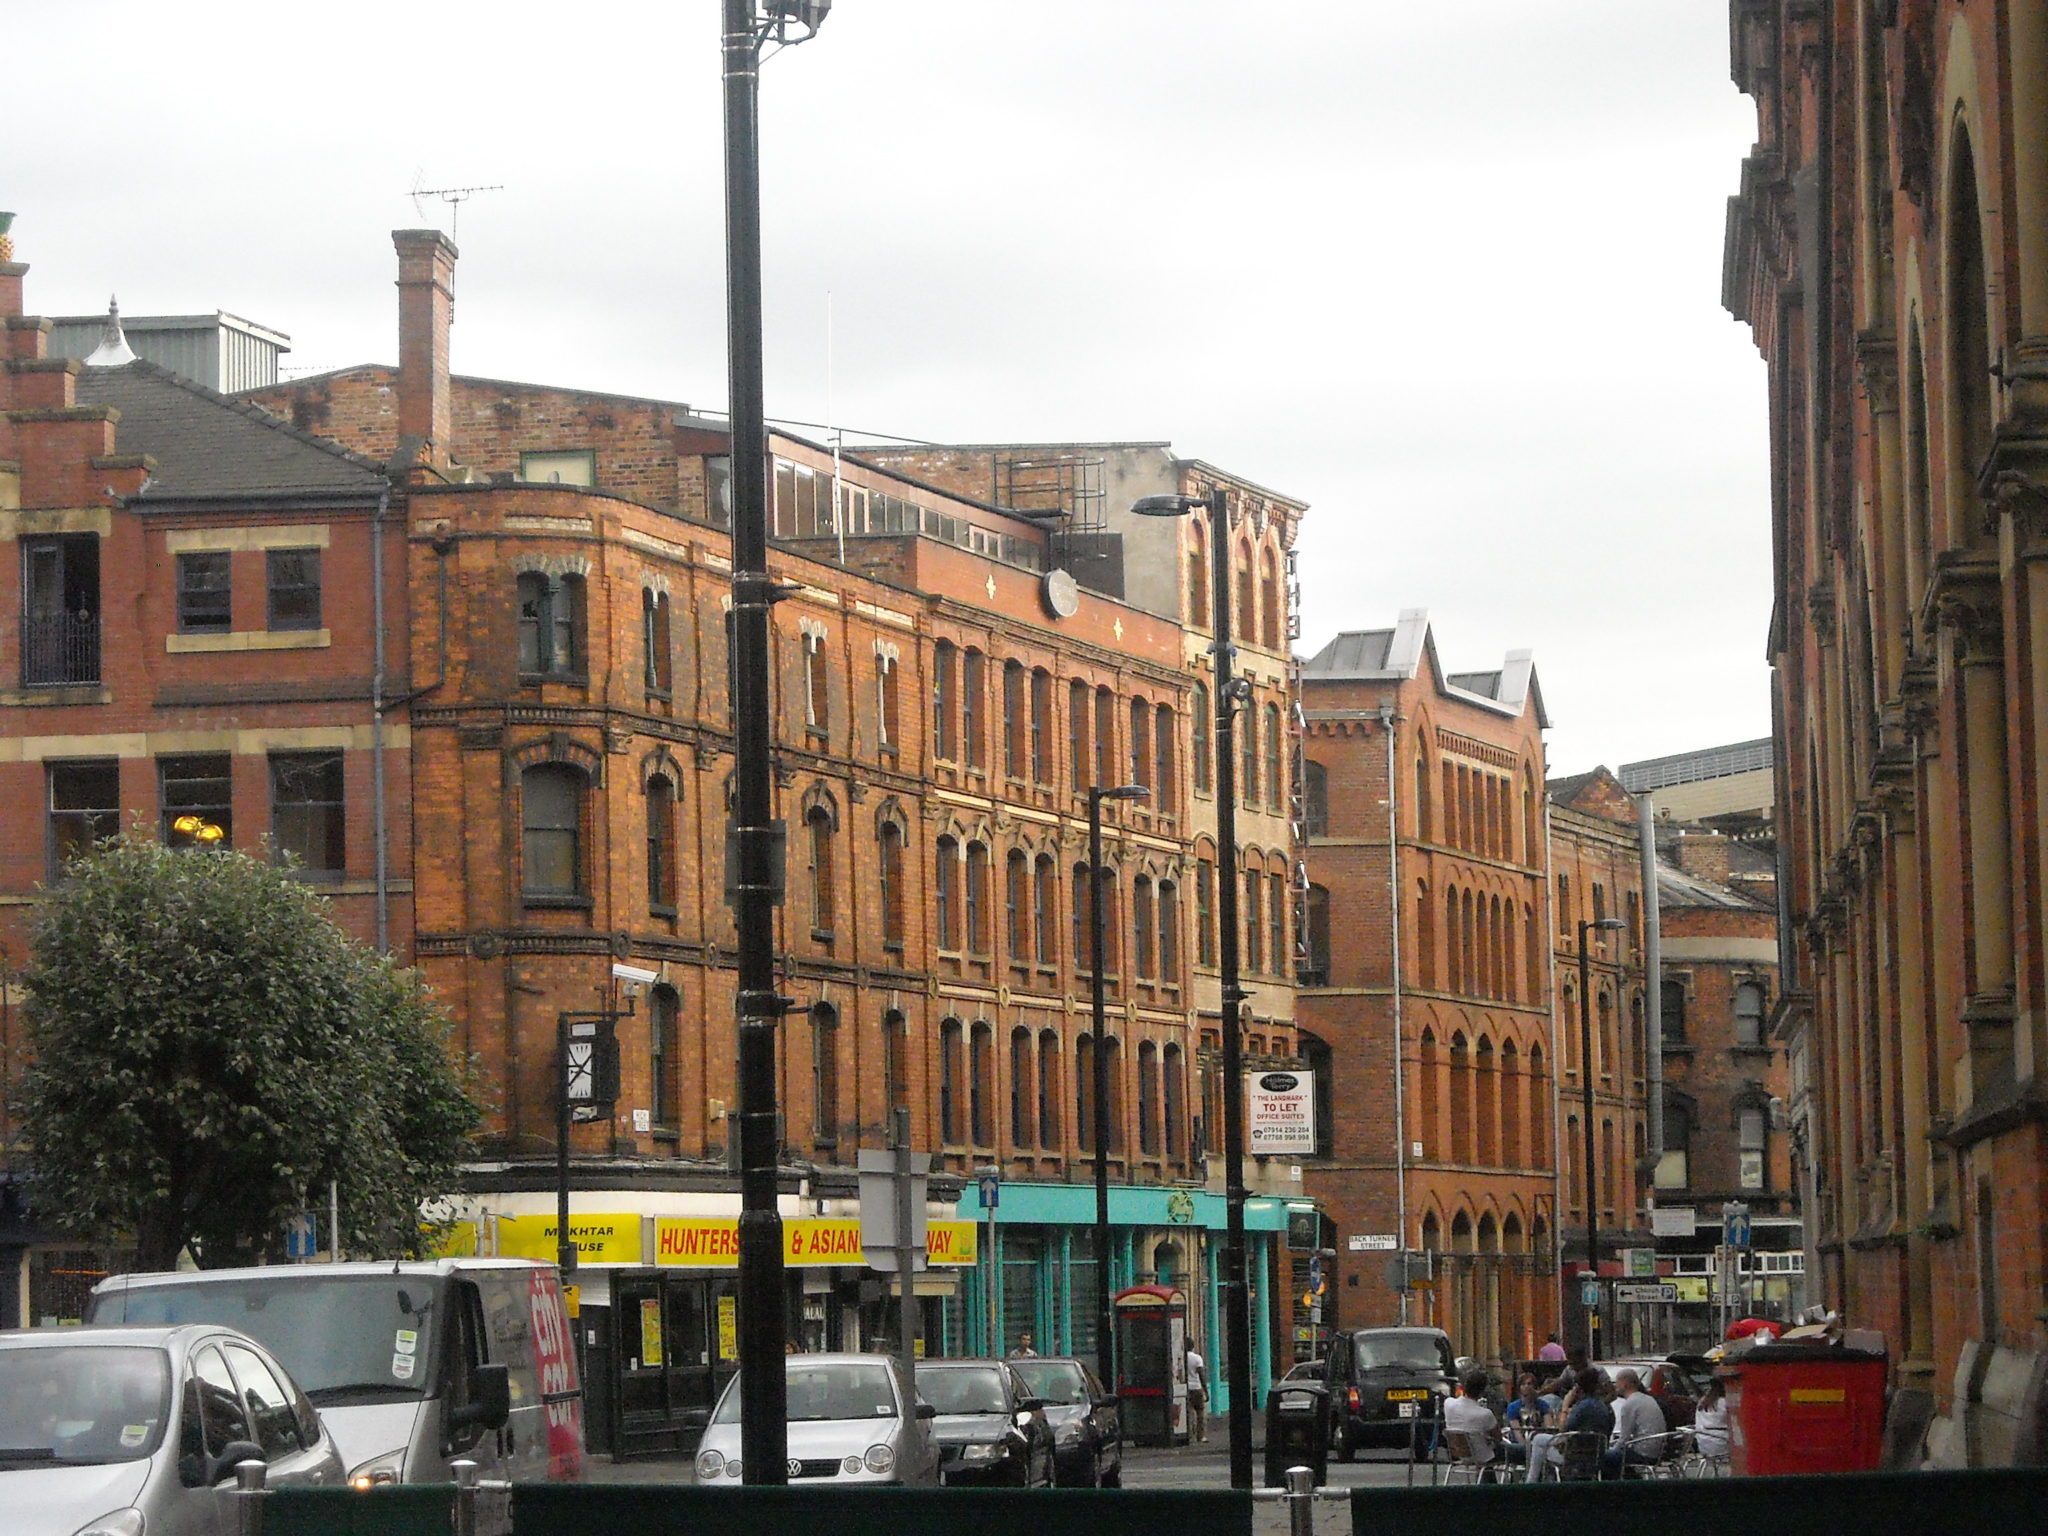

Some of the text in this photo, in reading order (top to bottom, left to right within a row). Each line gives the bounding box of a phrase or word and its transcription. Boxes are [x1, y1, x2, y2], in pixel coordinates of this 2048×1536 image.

[1263, 1103, 1298, 1112] TO LET
[544, 1226, 614, 1237] MKHTAR
[791, 1229, 803, 1255] &
[809, 1229, 859, 1254] ASIAN
